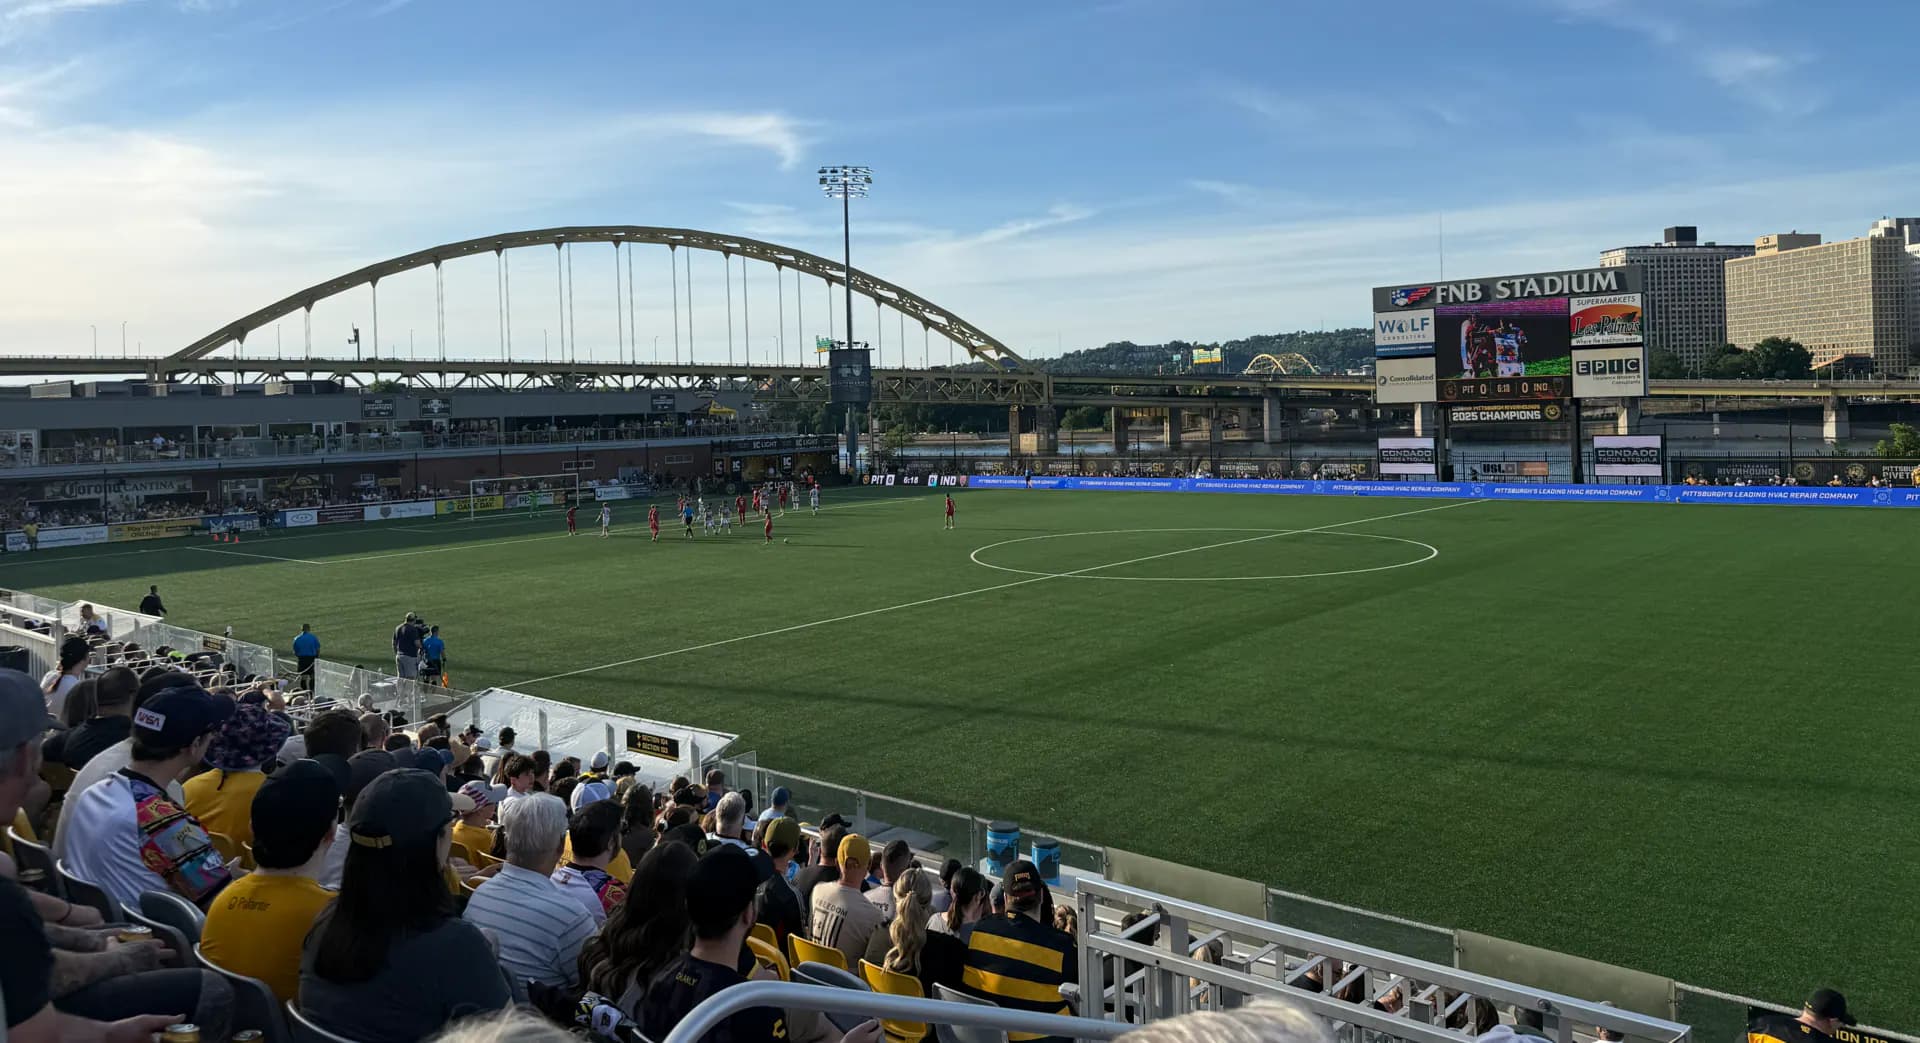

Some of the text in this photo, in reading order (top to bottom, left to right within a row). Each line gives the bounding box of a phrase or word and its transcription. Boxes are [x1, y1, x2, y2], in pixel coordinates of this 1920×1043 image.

[1435, 270, 1618, 304] FNB STADIUM
[1576, 295, 1636, 306] SUPERMARKETS
[1600, 314, 1640, 336] Palmas
[1578, 359, 1638, 373] EPIC
[1389, 374, 1434, 382] Consolidated
[1462, 385, 1474, 394] PIT
[1480, 384, 1486, 394] 0
[1522, 382, 1528, 393] 0
[1534, 382, 1548, 392] IND
[1452, 410, 1541, 421] 2025 CHAMPIONS
[1482, 463, 1505, 474] USL
[125, 480, 174, 492] CANTINA
[870, 475, 885, 484] PIT
[940, 476, 956, 486] IND
[138, 710, 160, 728] NASA
[642, 734, 659, 744] SECTION
[642, 742, 660, 752] SECTION
[1836, 1030, 1860, 1043] ION
